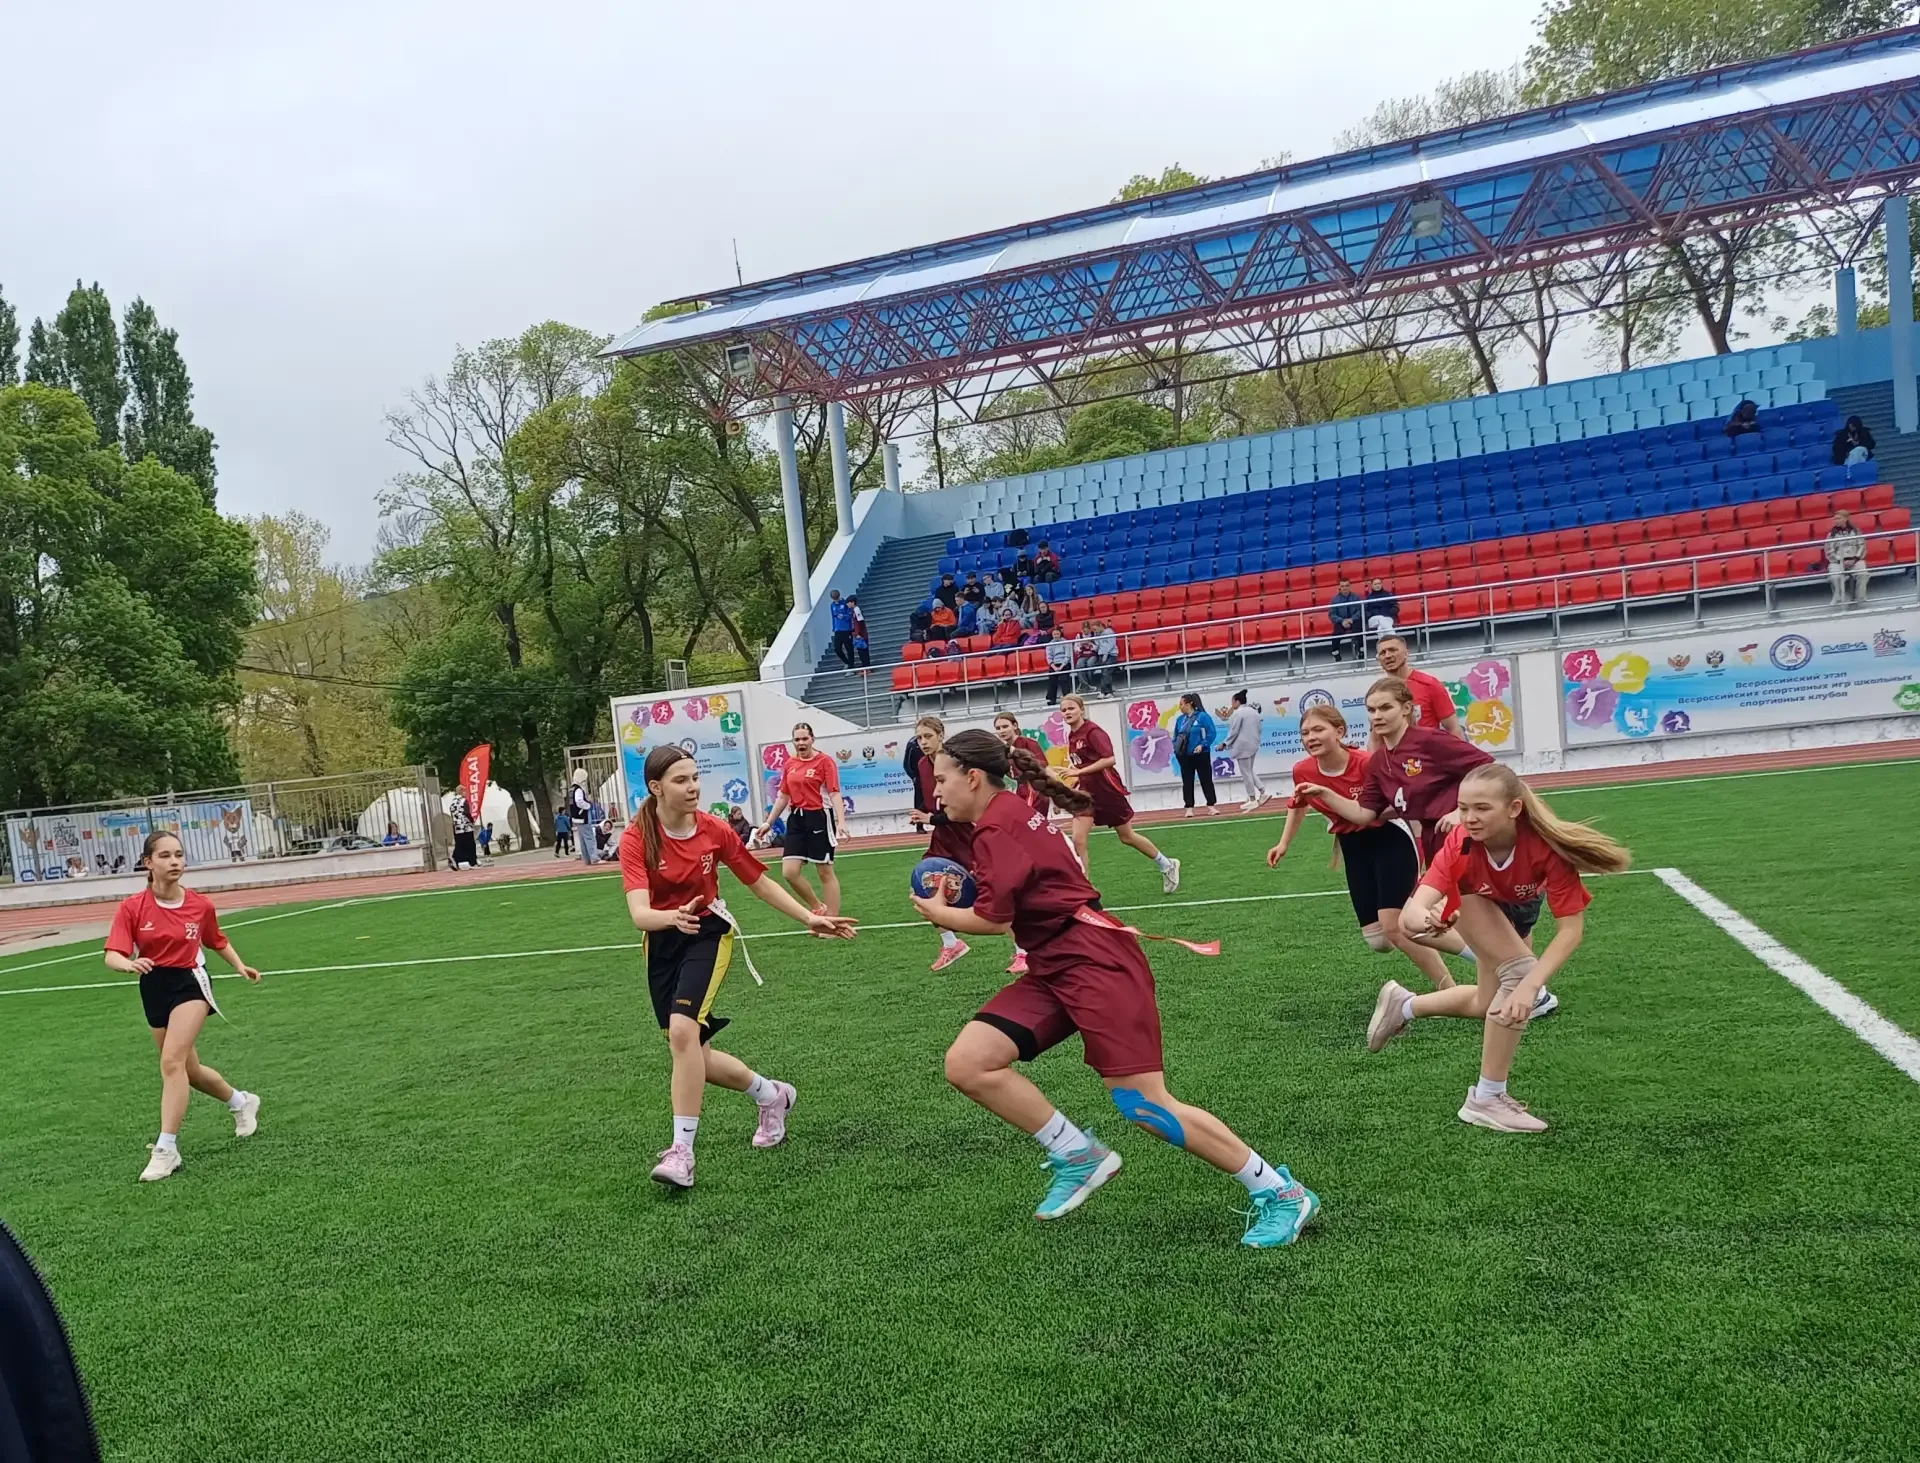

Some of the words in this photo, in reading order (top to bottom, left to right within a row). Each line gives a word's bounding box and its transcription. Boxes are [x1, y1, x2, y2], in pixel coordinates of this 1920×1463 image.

[1735, 672, 1820, 689] Всероссийский
[1823, 671, 1848, 679] этап
[1678, 690, 1760, 705] Всероссийских
[1762, 683, 1829, 695] спортивных
[1831, 681, 1852, 689] игр
[1854, 674, 1913, 686] школьных
[1739, 695, 1806, 708] спортивных
[1808, 690, 1848, 701] клубов
[1351, 731, 1368, 739] игр
[1394, 786, 1407, 812] 4
